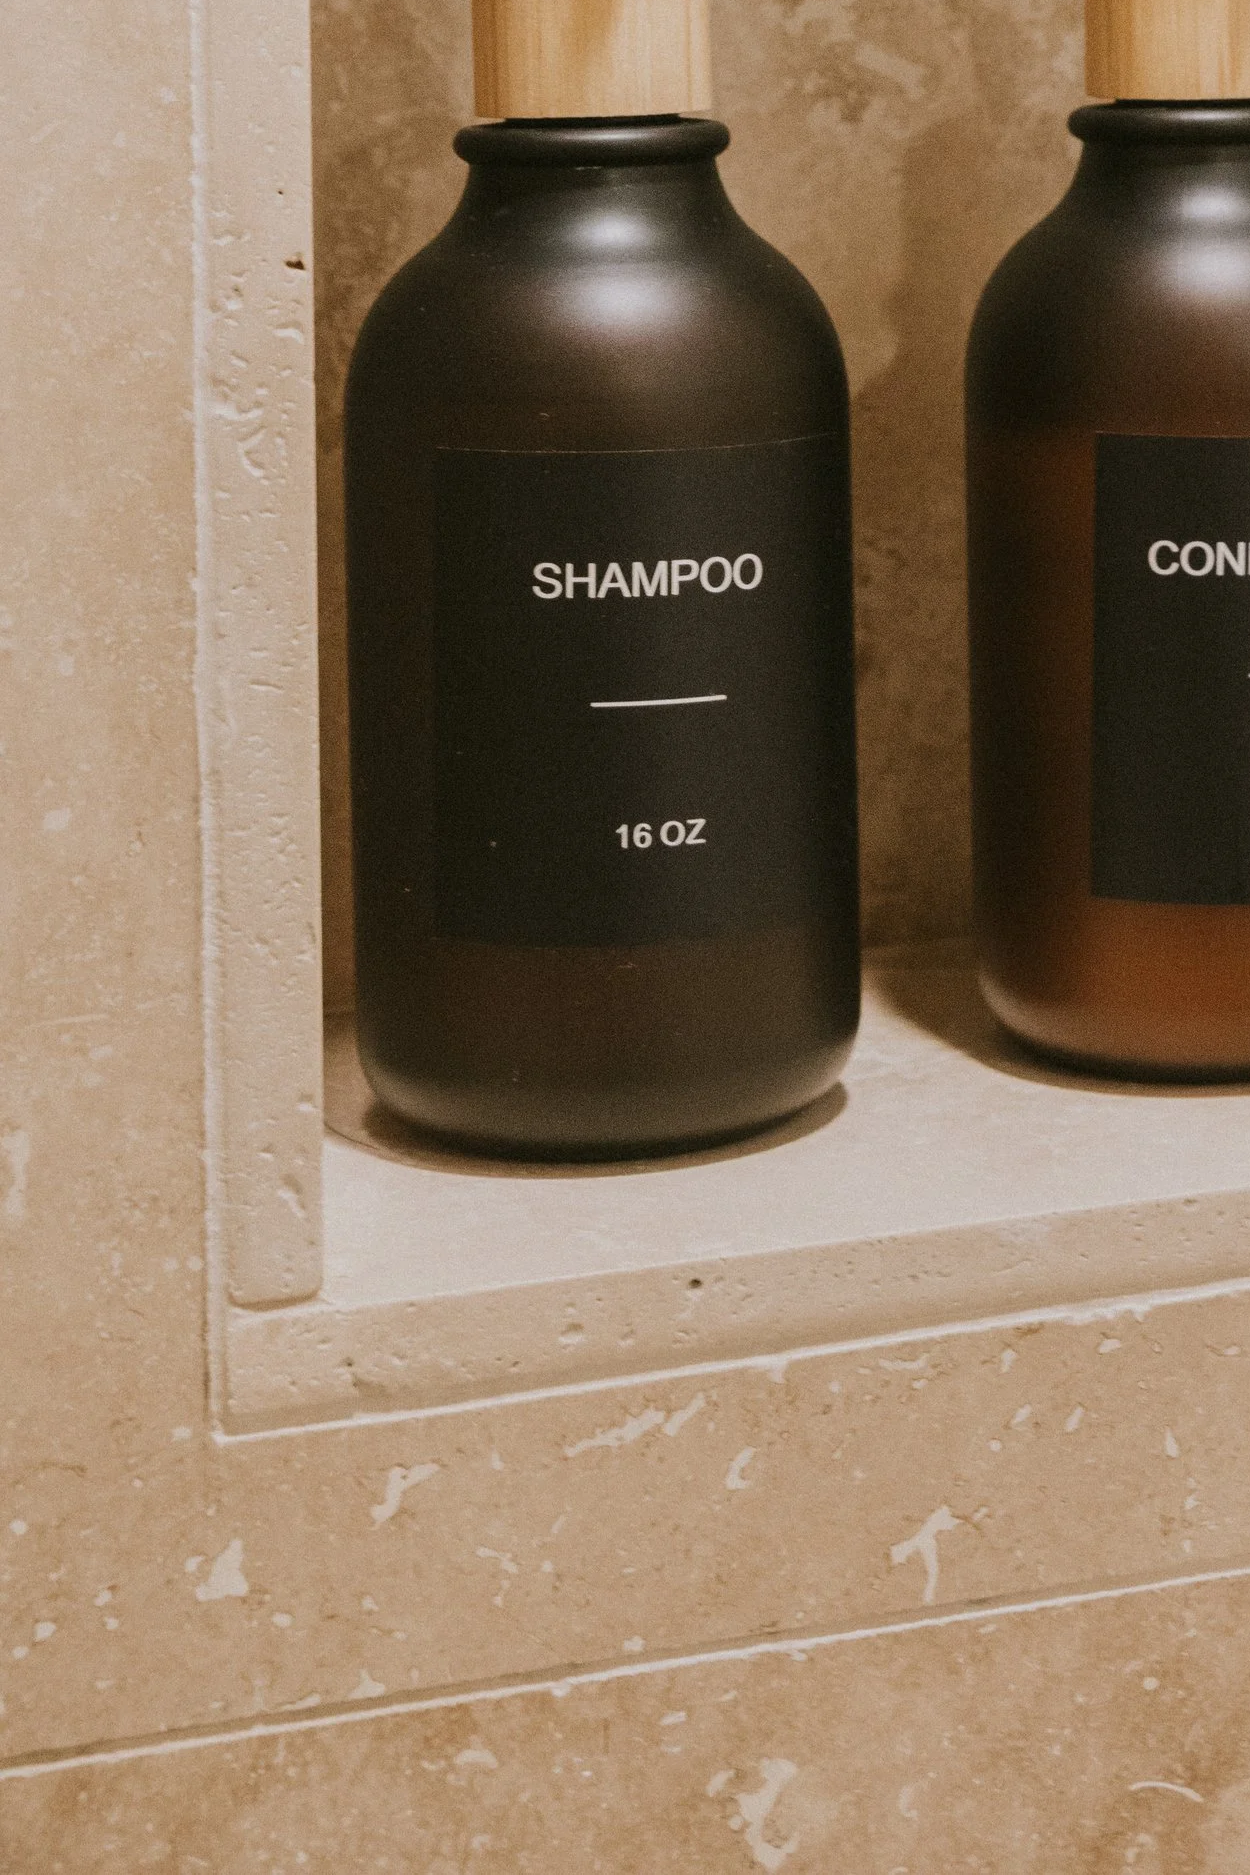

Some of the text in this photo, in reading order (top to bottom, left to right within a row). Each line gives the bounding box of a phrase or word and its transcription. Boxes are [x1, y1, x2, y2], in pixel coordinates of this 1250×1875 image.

[531, 553, 764, 600] SHAMPOO
[615, 818, 707, 850] 16 OZ
